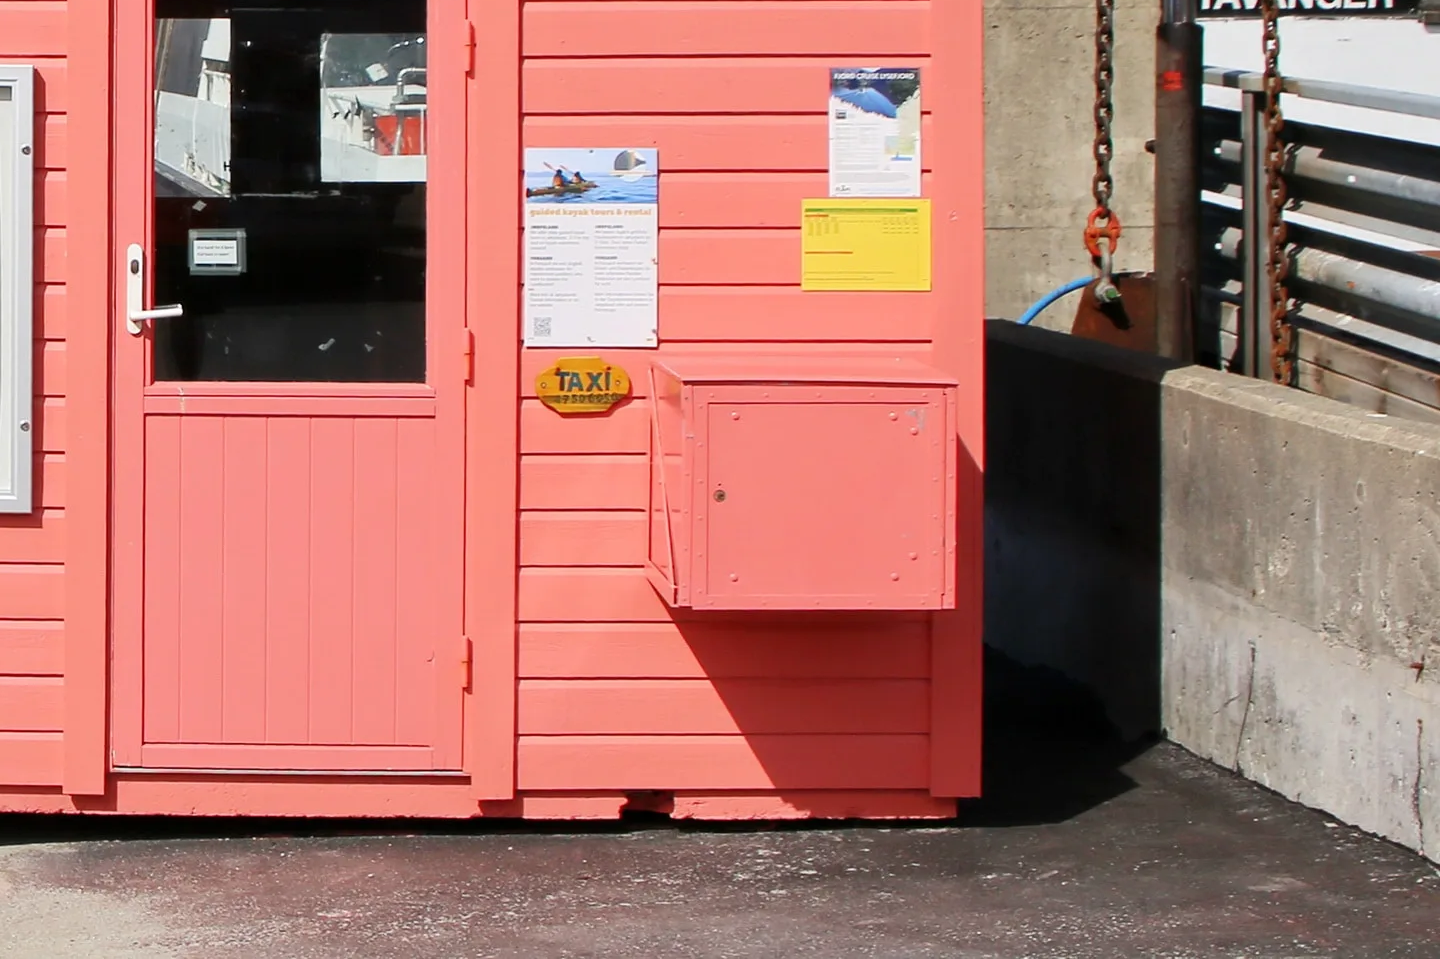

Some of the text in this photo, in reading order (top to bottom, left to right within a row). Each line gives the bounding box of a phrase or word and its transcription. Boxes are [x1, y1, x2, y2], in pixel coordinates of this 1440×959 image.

[529, 208, 561, 217] guided
[562, 208, 589, 217] kayak
[590, 208, 614, 216] tours
[624, 208, 652, 216] rental
[555, 371, 611, 391] TAXI
